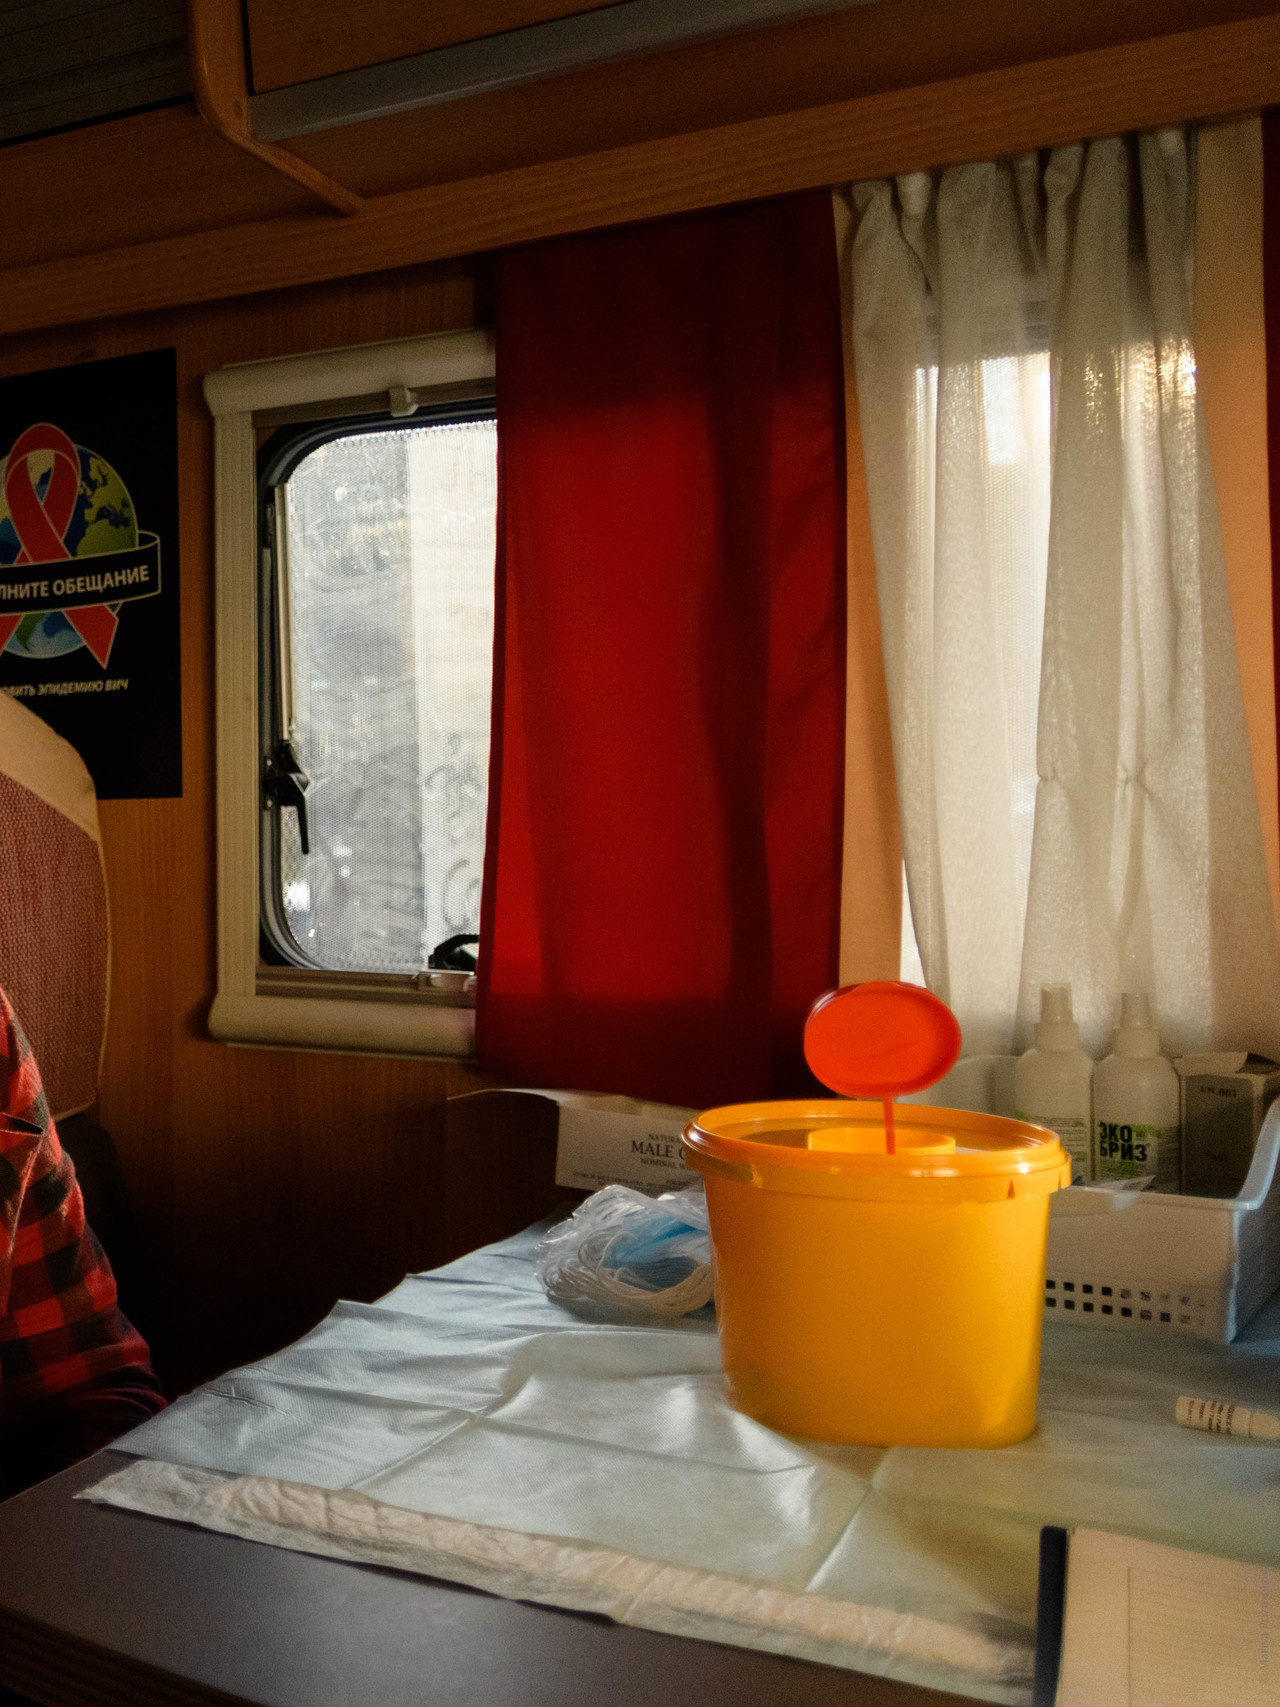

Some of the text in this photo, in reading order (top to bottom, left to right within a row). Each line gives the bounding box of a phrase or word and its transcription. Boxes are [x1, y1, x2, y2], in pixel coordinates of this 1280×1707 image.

[52, 565, 151, 595] ОБЕЩАНИЕ
[0, 678, 129, 697] ОВИТЬ ЭПИДЕМИЮ ВИЧ
[648, 1134, 681, 1144] NATURA
[1099, 1120, 1133, 1143] ЭКО
[631, 1139, 674, 1158] MALE
[1100, 1139, 1148, 1162] БРИЗ
[640, 1157, 677, 1169] NOMINAL
